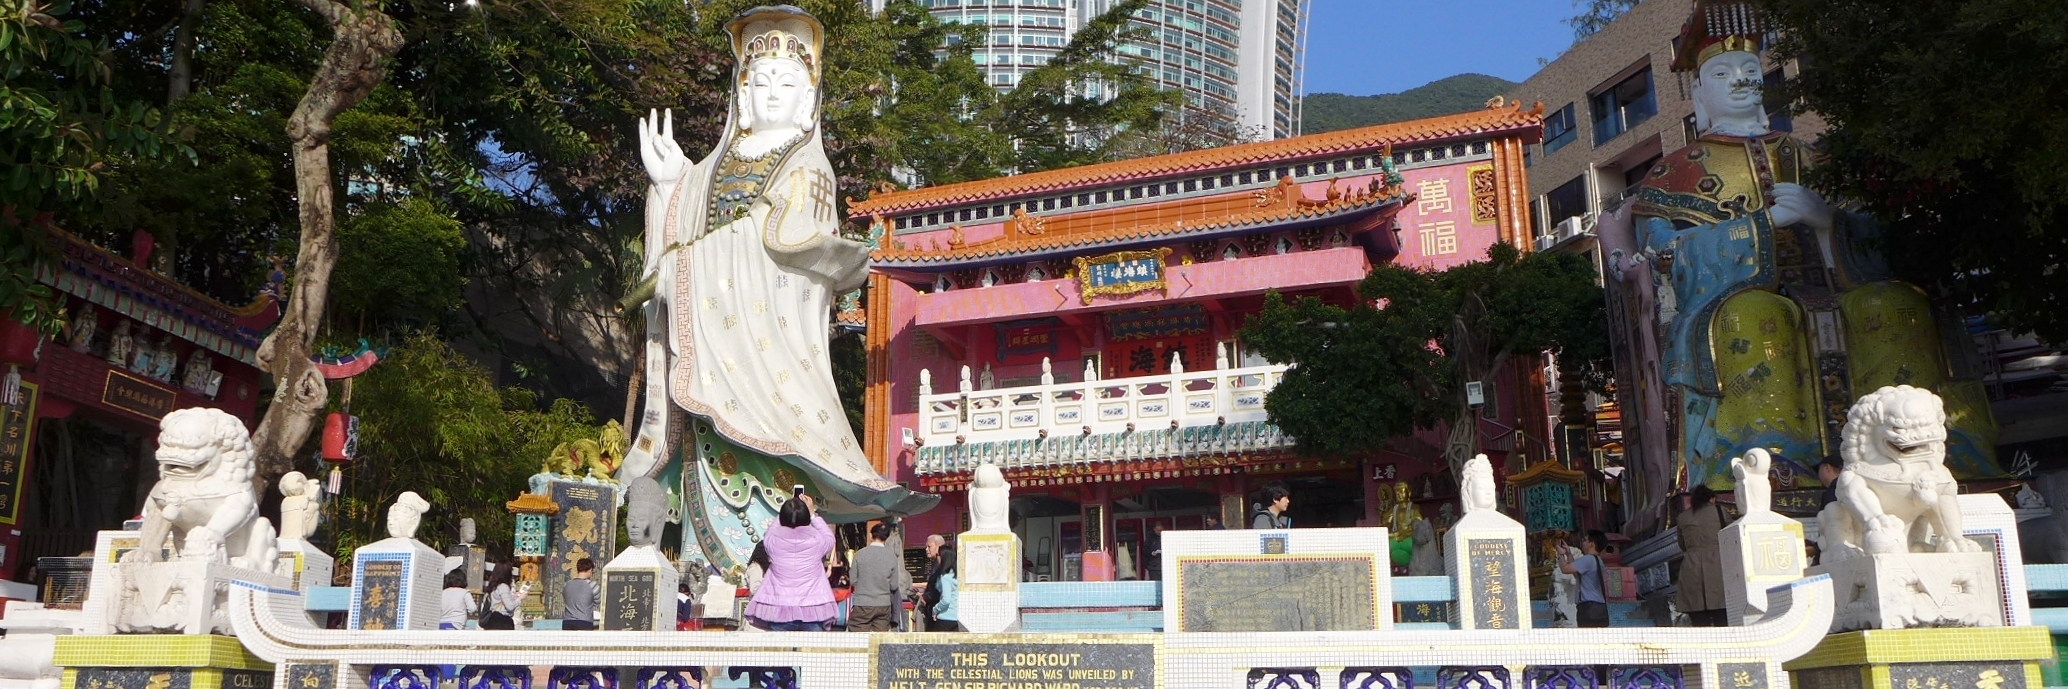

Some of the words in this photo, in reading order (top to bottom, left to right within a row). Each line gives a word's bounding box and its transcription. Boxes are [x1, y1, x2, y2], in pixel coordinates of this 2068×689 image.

[1416, 178, 1457, 257] 萬福
[1756, 535, 1792, 570] 福
[1484, 561, 1506, 629] 望海觀音
[896, 668, 920, 679] WITH
[926, 668, 944, 679] THE
[951, 668, 1003, 680] CELESTIAL
[1009, 669, 1038, 680] LIONS
[1043, 669, 1062, 680] WAS
[1069, 669, 1116, 680] UNVEILED
[1122, 669, 1134, 680] BY
[951, 652, 988, 667] THIS
[1003, 652, 1080, 667] LOOKOUT
